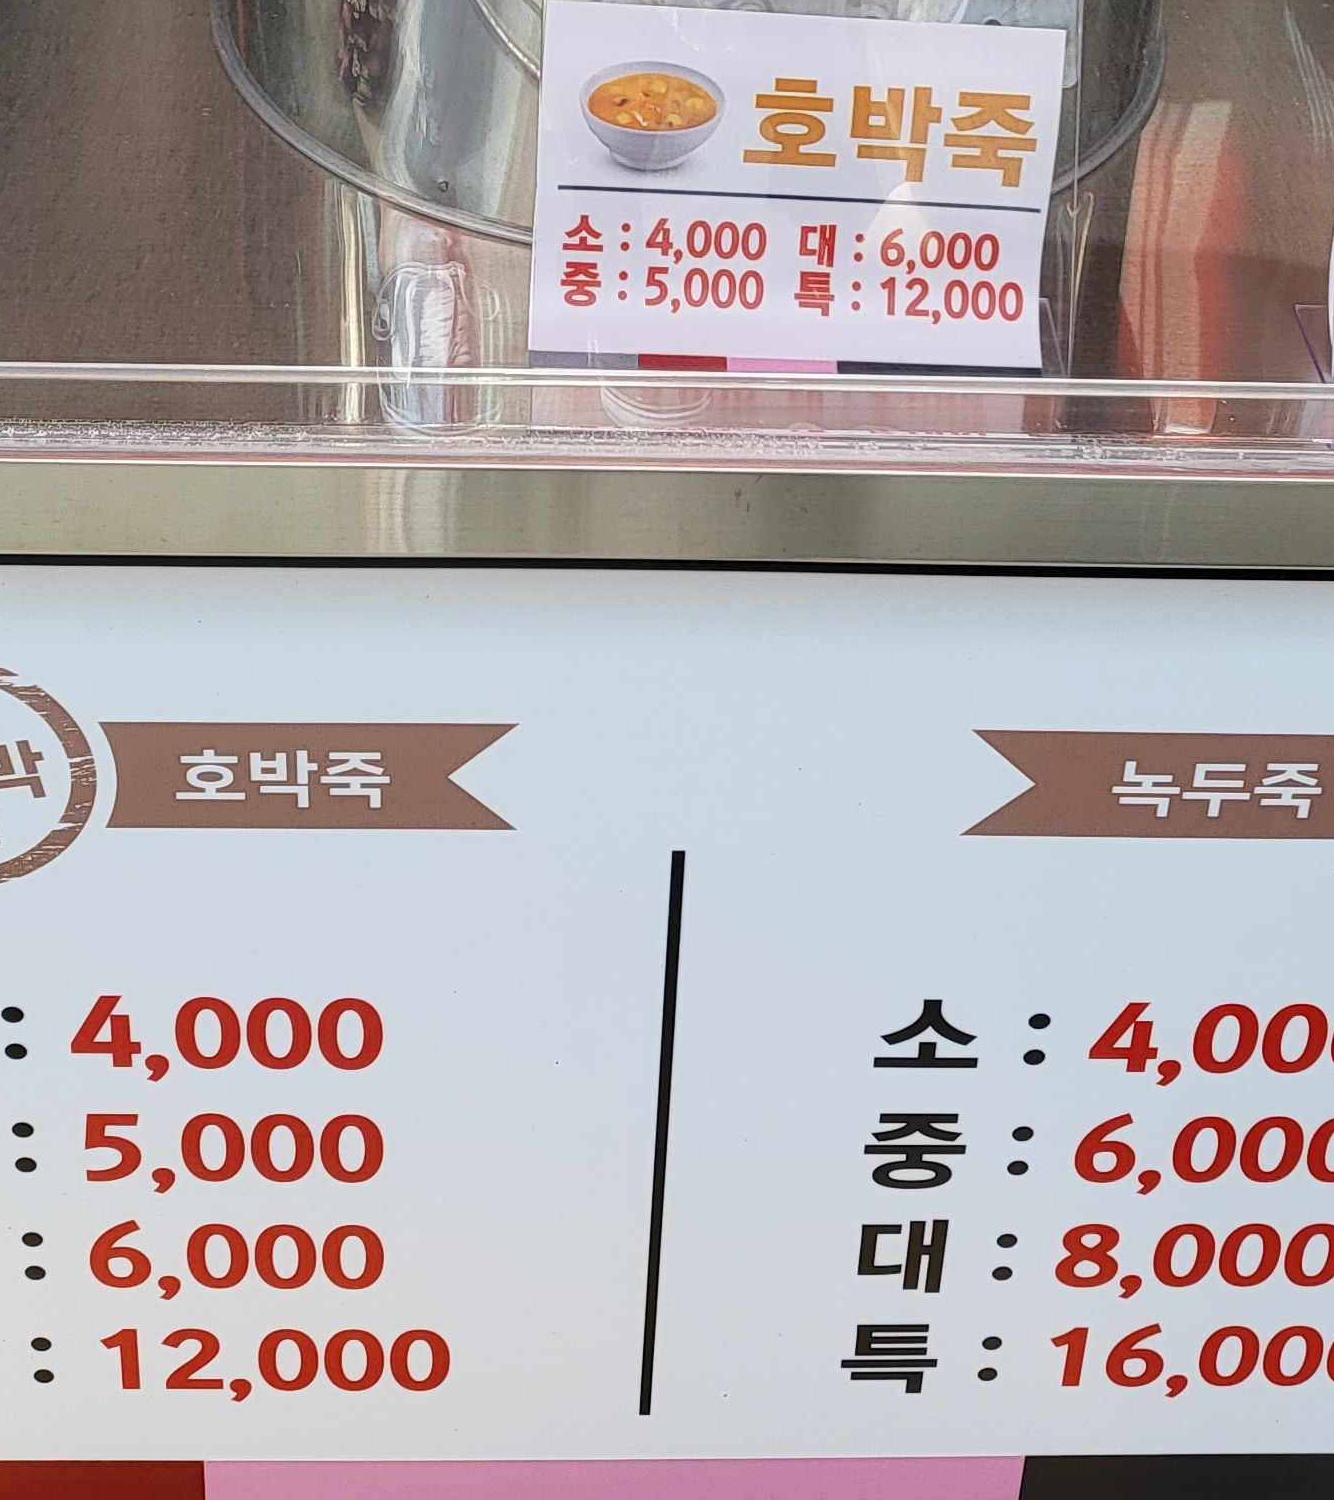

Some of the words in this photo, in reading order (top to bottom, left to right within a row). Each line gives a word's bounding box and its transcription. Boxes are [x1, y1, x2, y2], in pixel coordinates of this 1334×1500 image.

[743, 78, 1037, 187] 호박죽
[562, 215, 603, 252] 소
[645, 218, 767, 264] 4,000
[799, 224, 837, 268] 대
[880, 229, 1000, 275] 6,000
[560, 261, 601, 306] 중
[645, 266, 764, 313] 5,000
[794, 271, 835, 316] 특
[881, 276, 1024, 324] 12,000
[176, 750, 390, 808] 호박죽
[1112, 761, 1322, 818] 녹두죽
[71, 996, 383, 1082] 4,000
[873, 999, 978, 1068] 소
[85, 1113, 383, 1194] 5,000
[864, 1113, 966, 1189] 중
[90, 1220, 384, 1300] 6,000
[857, 1220, 949, 1293] 대
[100, 1329, 450, 1402] 12,000
[841, 1324, 938, 1393] 특
